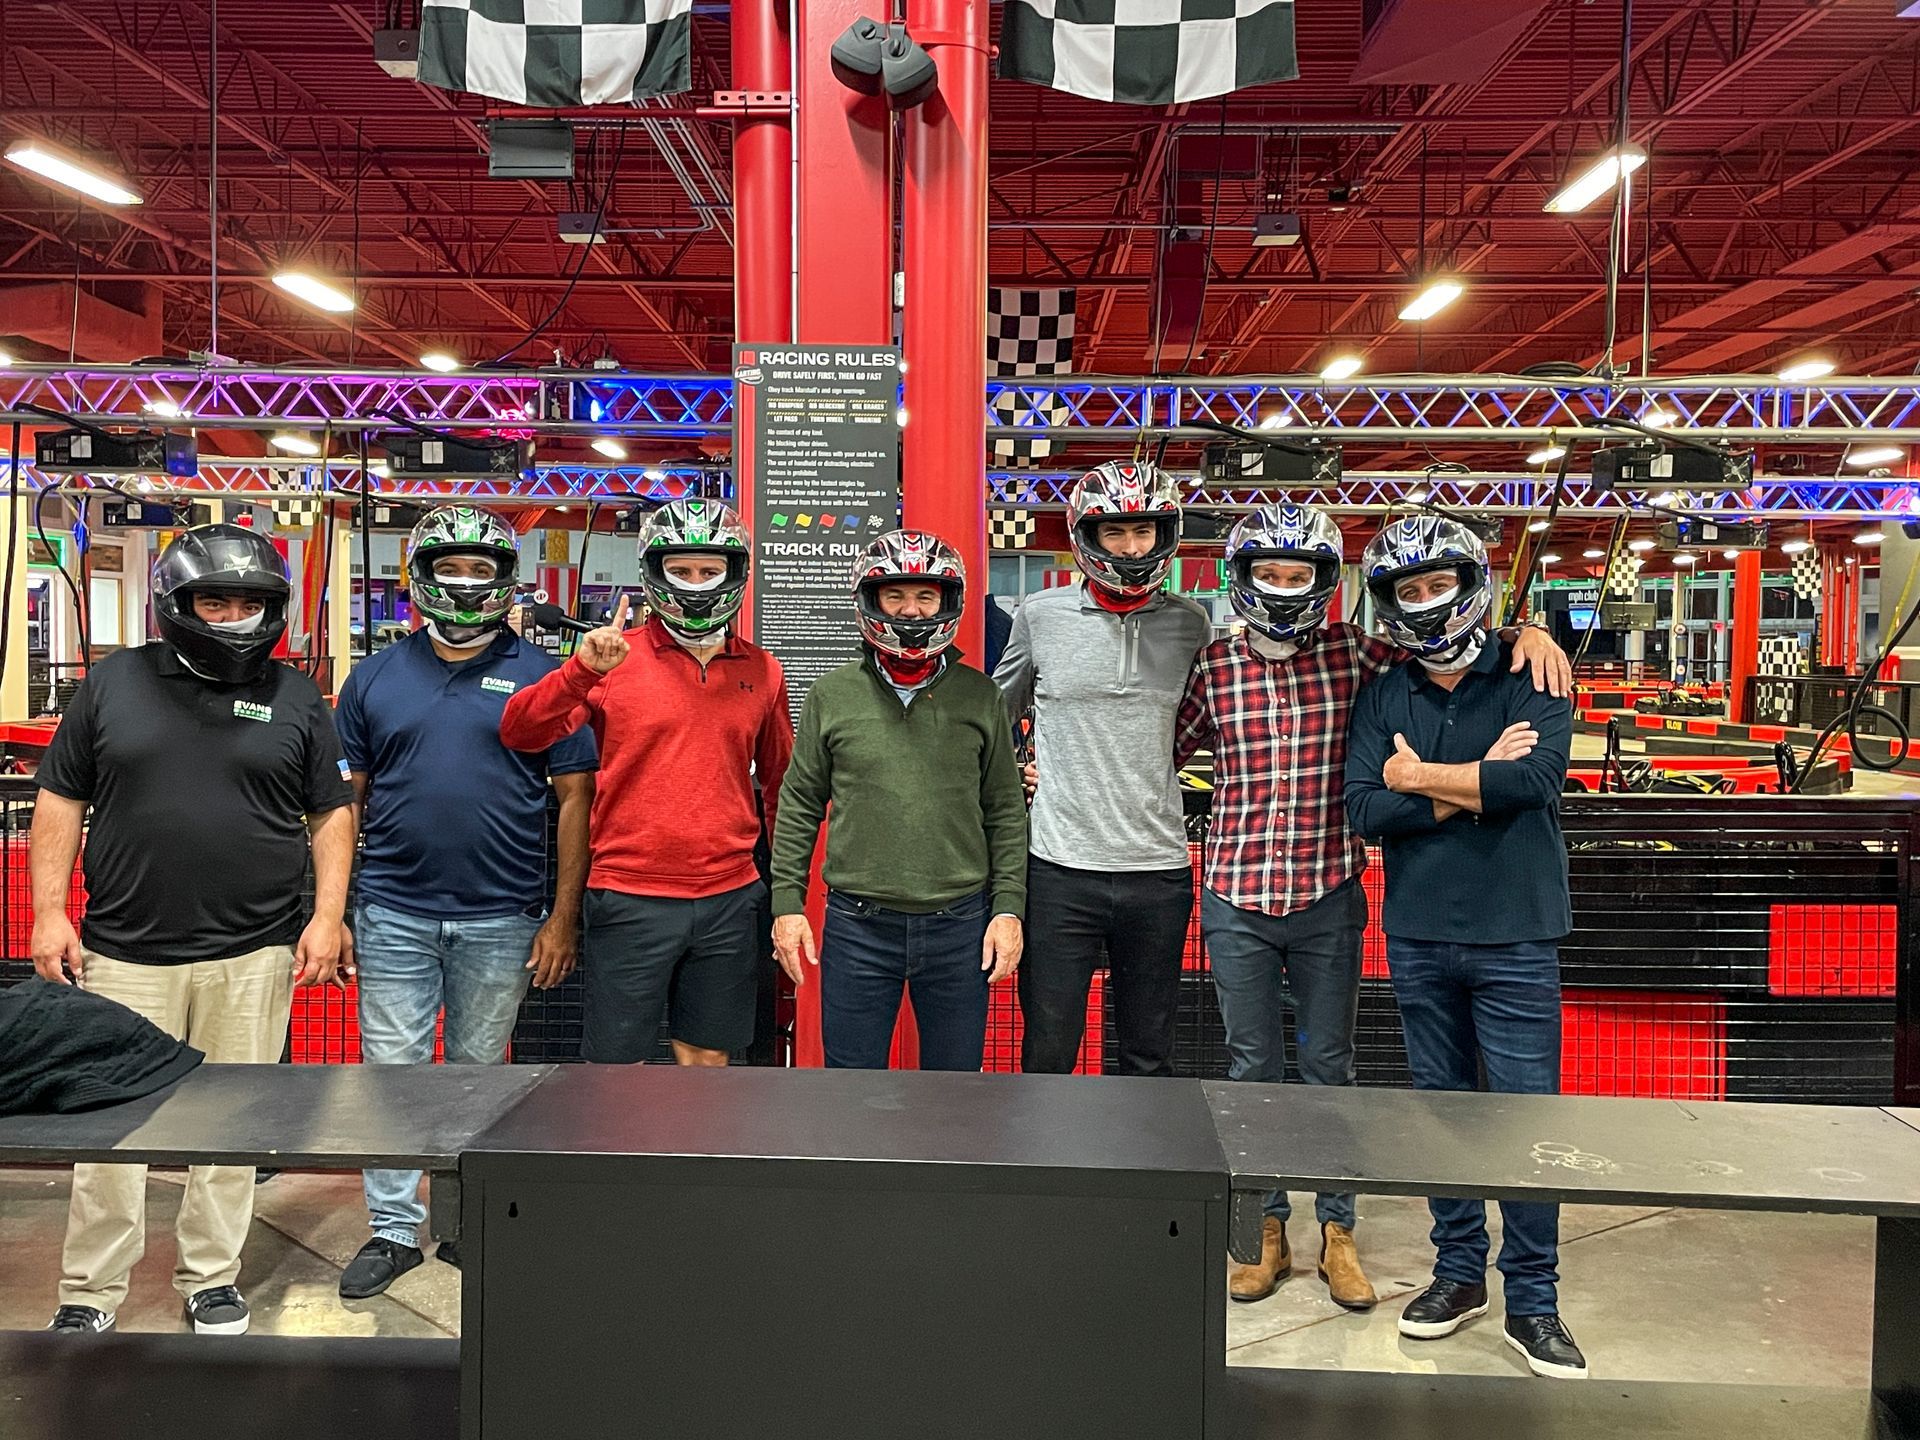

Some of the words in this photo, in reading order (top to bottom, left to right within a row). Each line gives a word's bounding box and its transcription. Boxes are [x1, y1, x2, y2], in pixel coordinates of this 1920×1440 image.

[760, 351, 830, 366] RACING
[835, 352, 896, 366] RULES
[761, 542, 824, 556] TRACK
[1568, 590, 1583, 604] mph
[1584, 590, 1599, 601] club
[482, 676, 516, 688] EVANS
[234, 700, 272, 715] EVANS
[1666, 720, 1682, 731] SLOW
